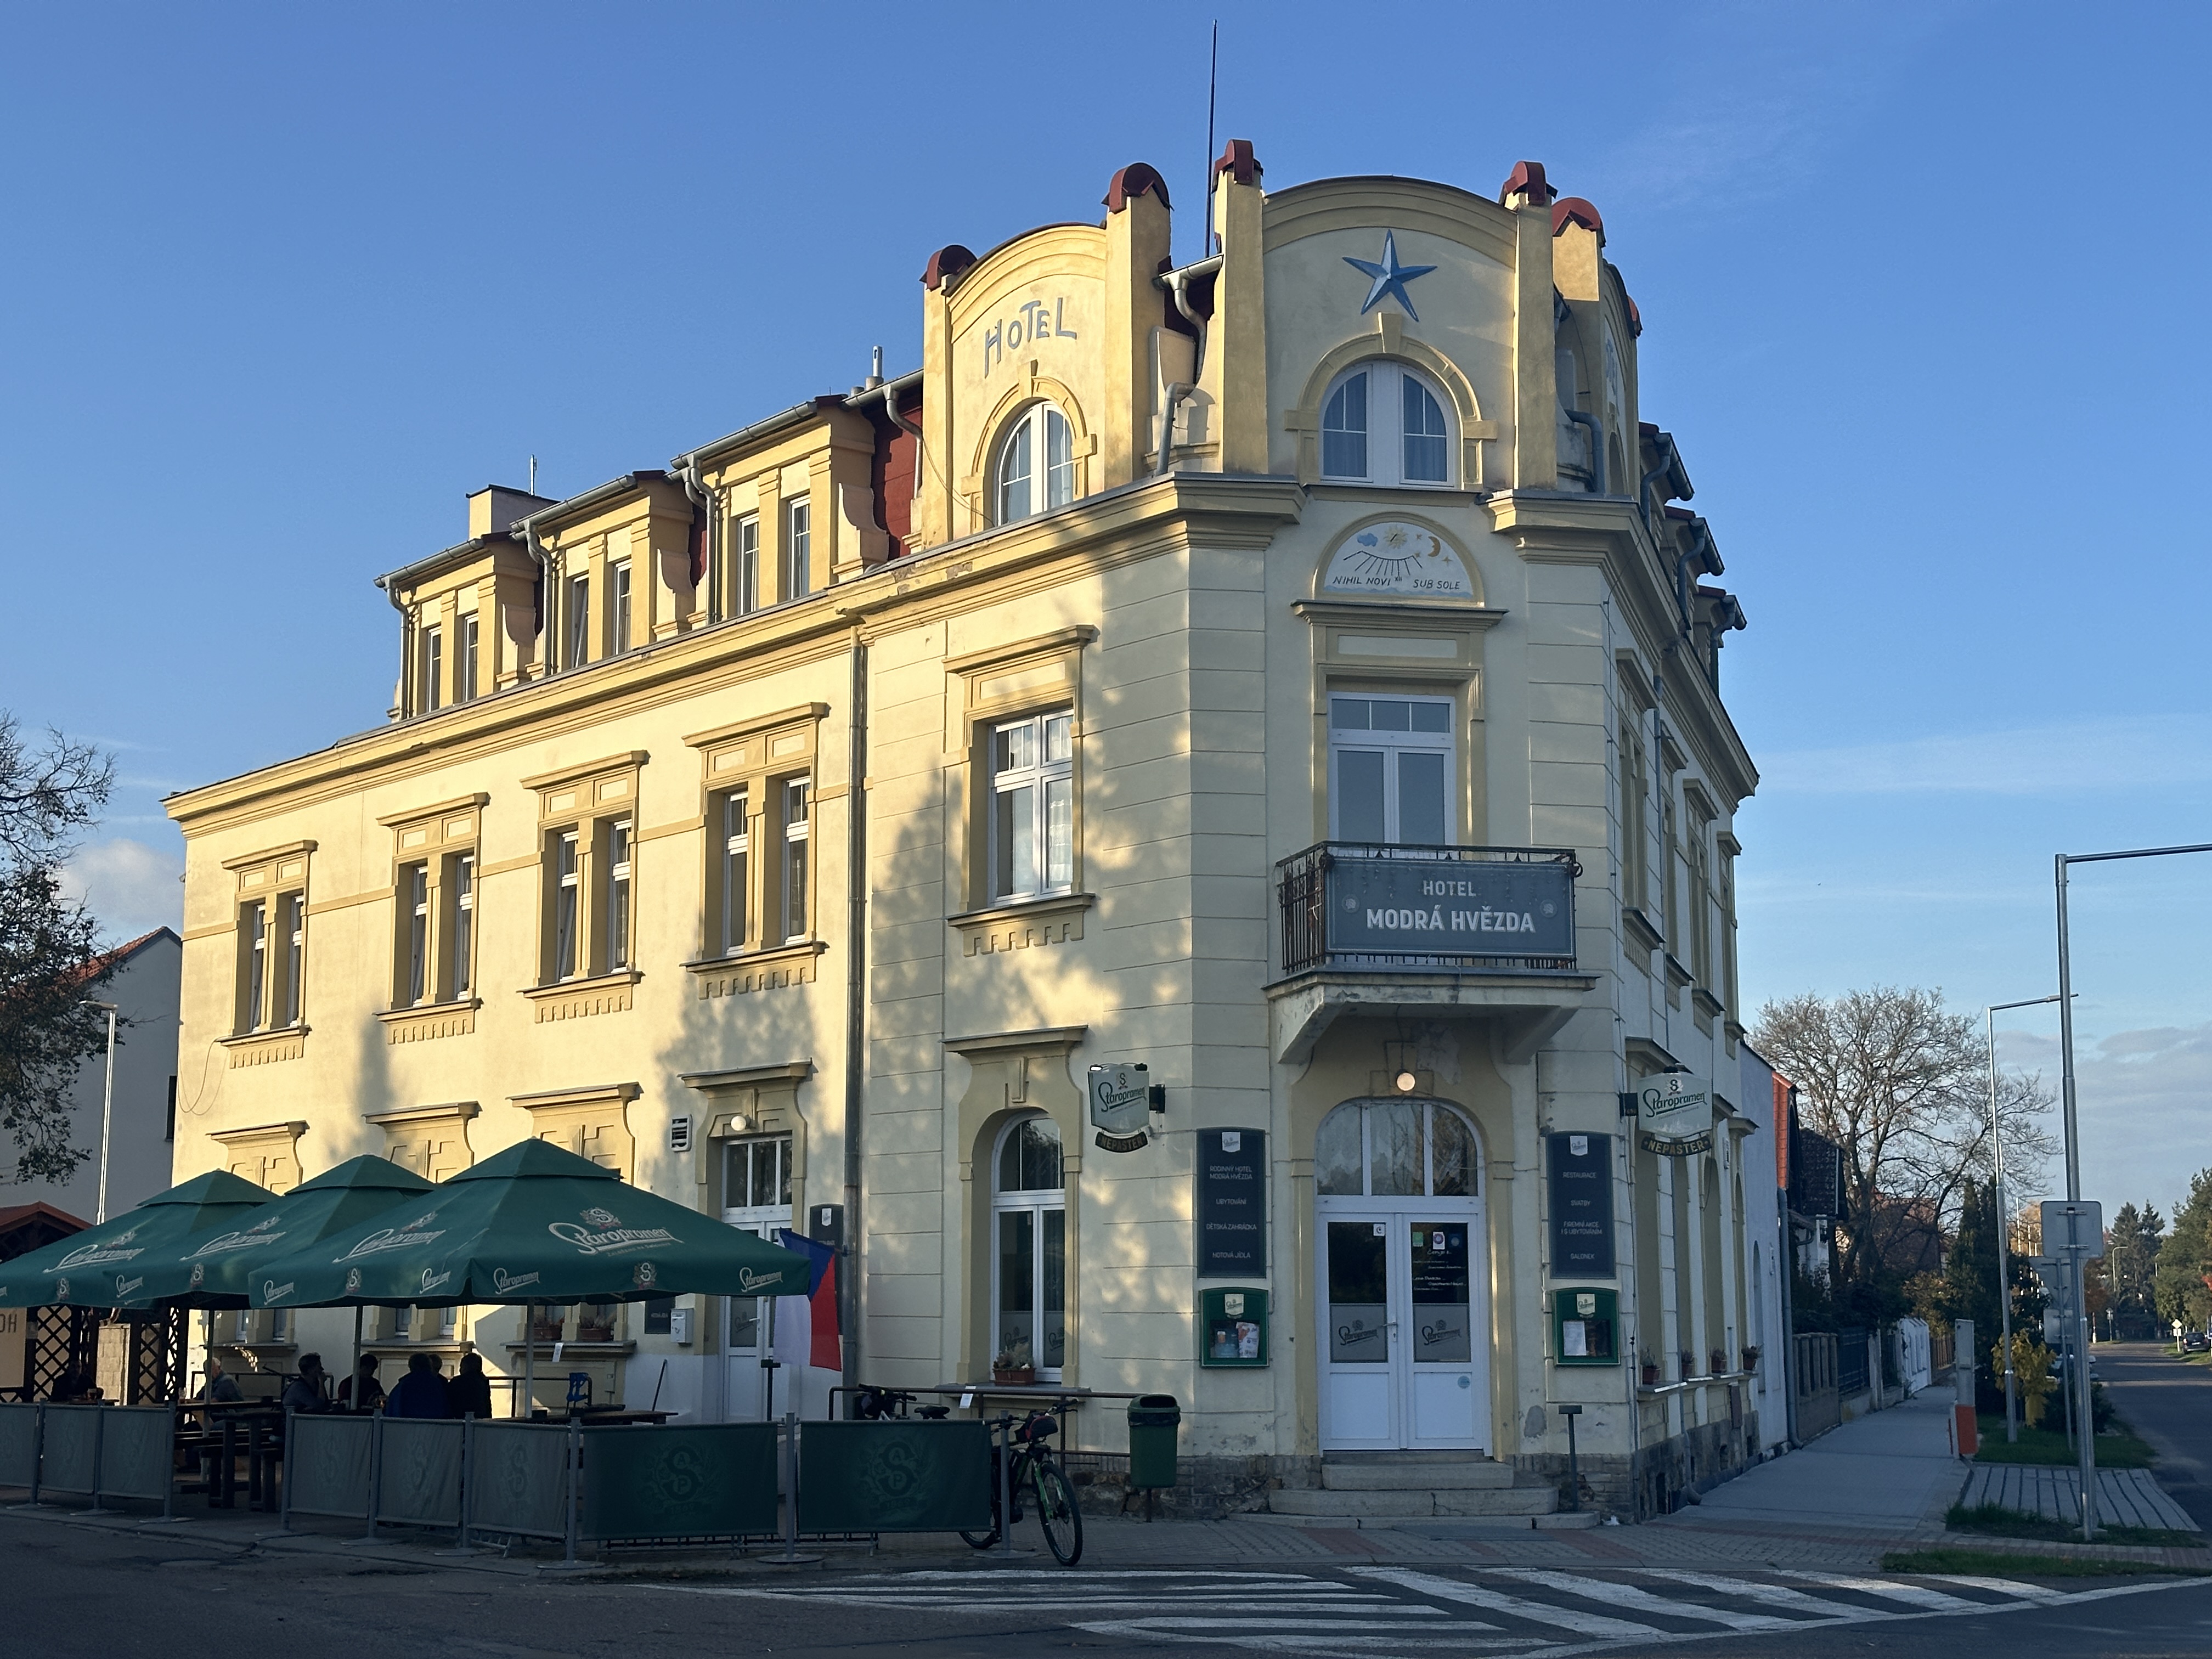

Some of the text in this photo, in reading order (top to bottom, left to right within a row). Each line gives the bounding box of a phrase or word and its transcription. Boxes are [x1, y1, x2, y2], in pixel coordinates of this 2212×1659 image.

[984, 297, 1077, 379] HOTEL
[1332, 575, 1460, 590] NIHIL NOVI SUB SOLE
[1423, 880, 1477, 897] HOTEL
[1366, 904, 1537, 933] MODRÁ HVĚZDA
[1098, 1081, 1147, 1113] Staropramen
[1643, 1088, 1708, 1118] Staropramen
[1101, 1135, 1143, 1150] NEPASTER
[1647, 1139, 1706, 1155] NEPASTER
[548, 1222, 685, 1255] Staropramen
[494, 1267, 540, 1295] Staropramen
[740, 1267, 783, 1293] Staropramen
